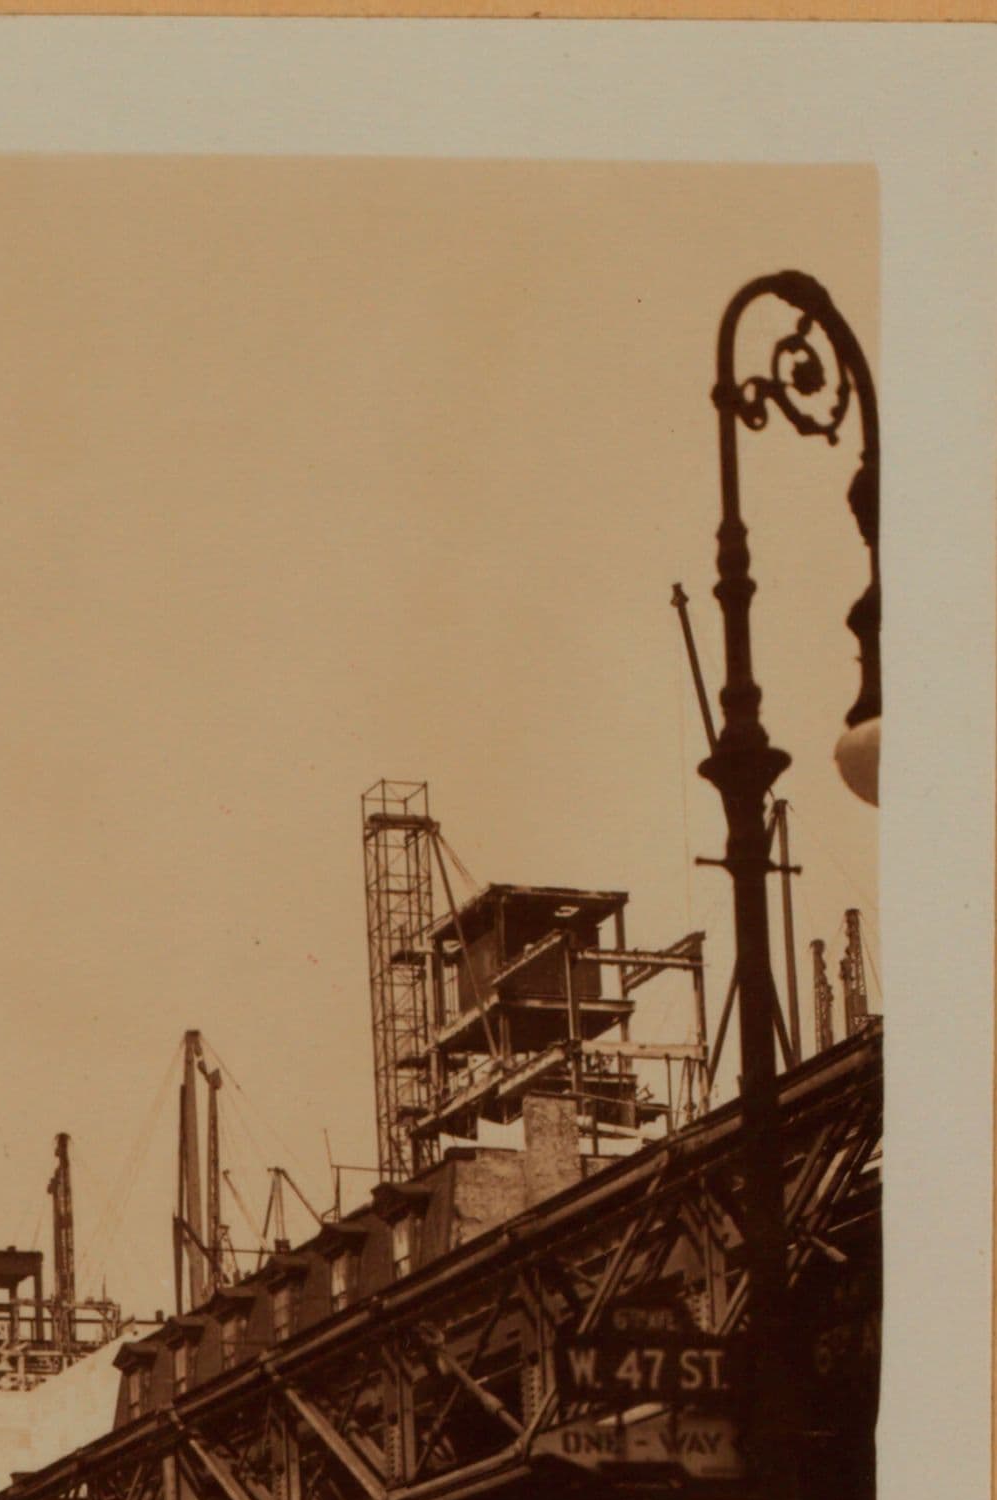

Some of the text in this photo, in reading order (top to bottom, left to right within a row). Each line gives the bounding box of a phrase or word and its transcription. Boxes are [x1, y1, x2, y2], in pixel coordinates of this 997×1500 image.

[567, 1348, 730, 1390] W. 47 ST.
